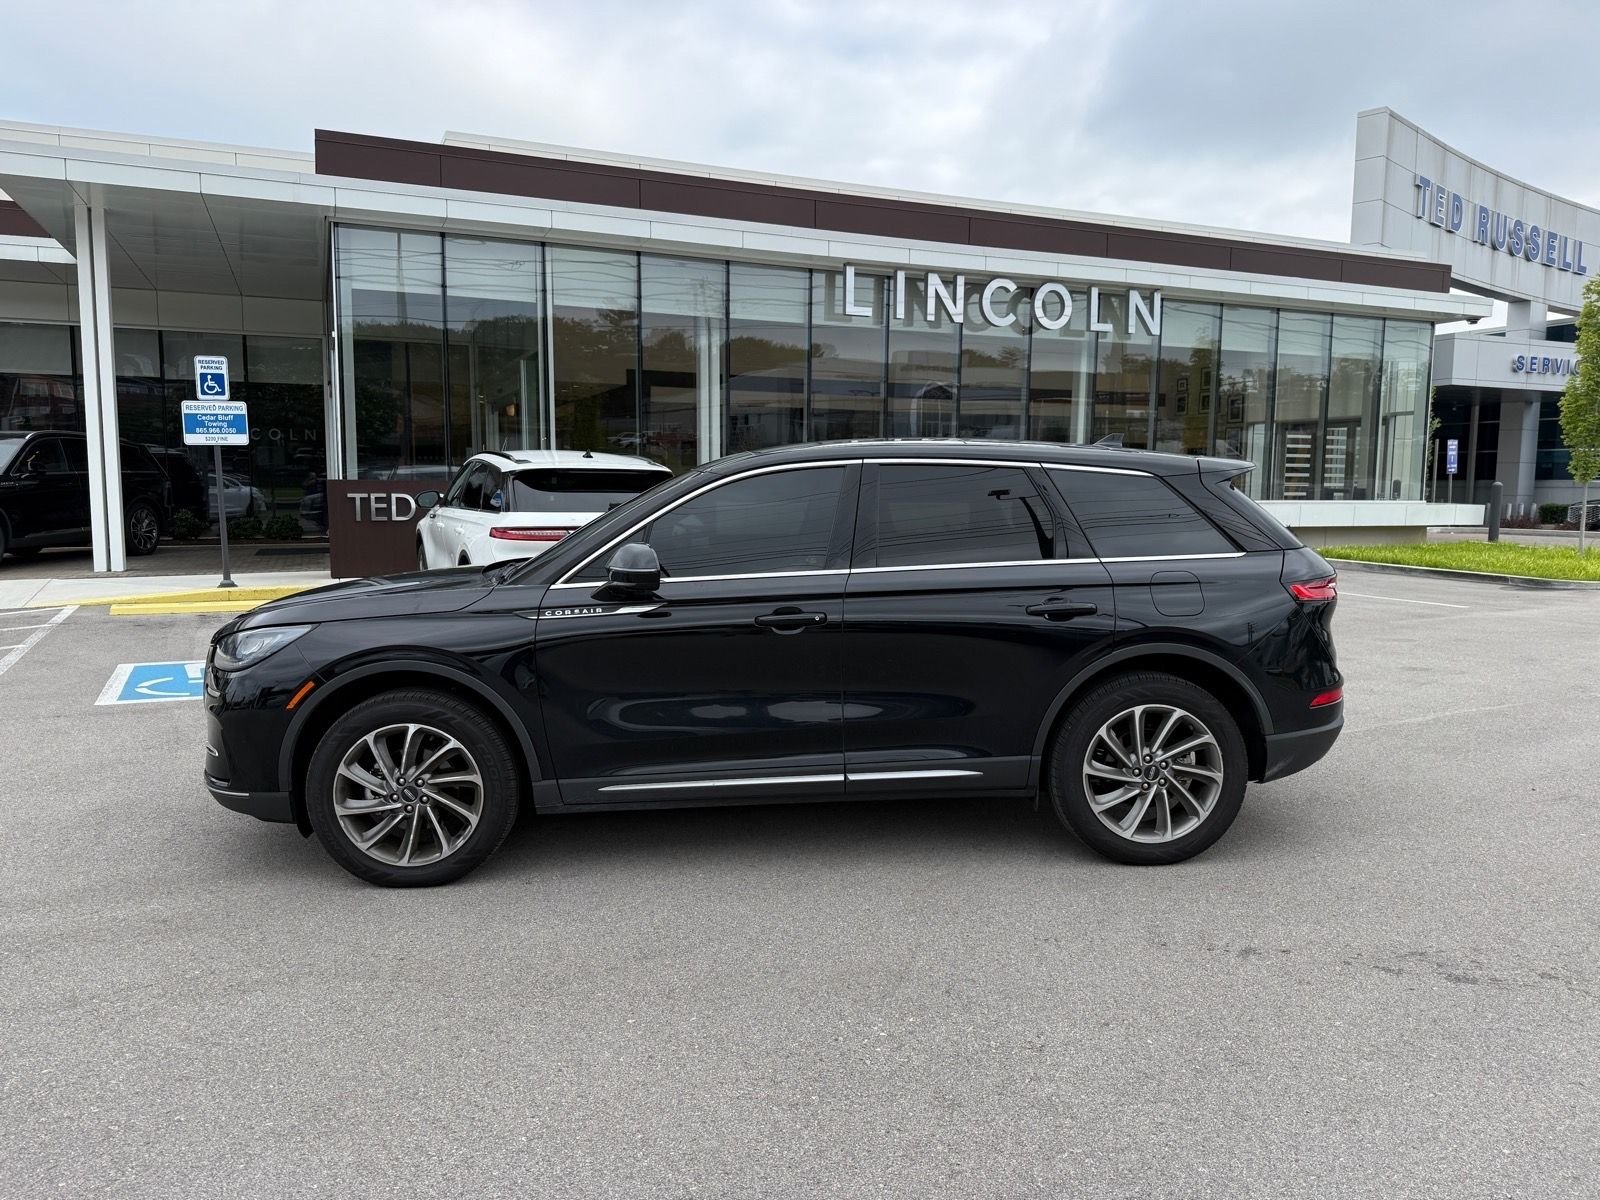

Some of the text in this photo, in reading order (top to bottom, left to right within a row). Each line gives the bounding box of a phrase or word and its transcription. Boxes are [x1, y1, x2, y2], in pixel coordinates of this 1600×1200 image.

[1416, 175, 1588, 275] TED RUSSELL
[843, 262, 1162, 336] LINCOLN
[1514, 354, 1582, 376] SERVIC
[204, 420, 228, 428] Towing
[347, 493, 417, 522] TED
[544, 607, 603, 617] CORSAIR
